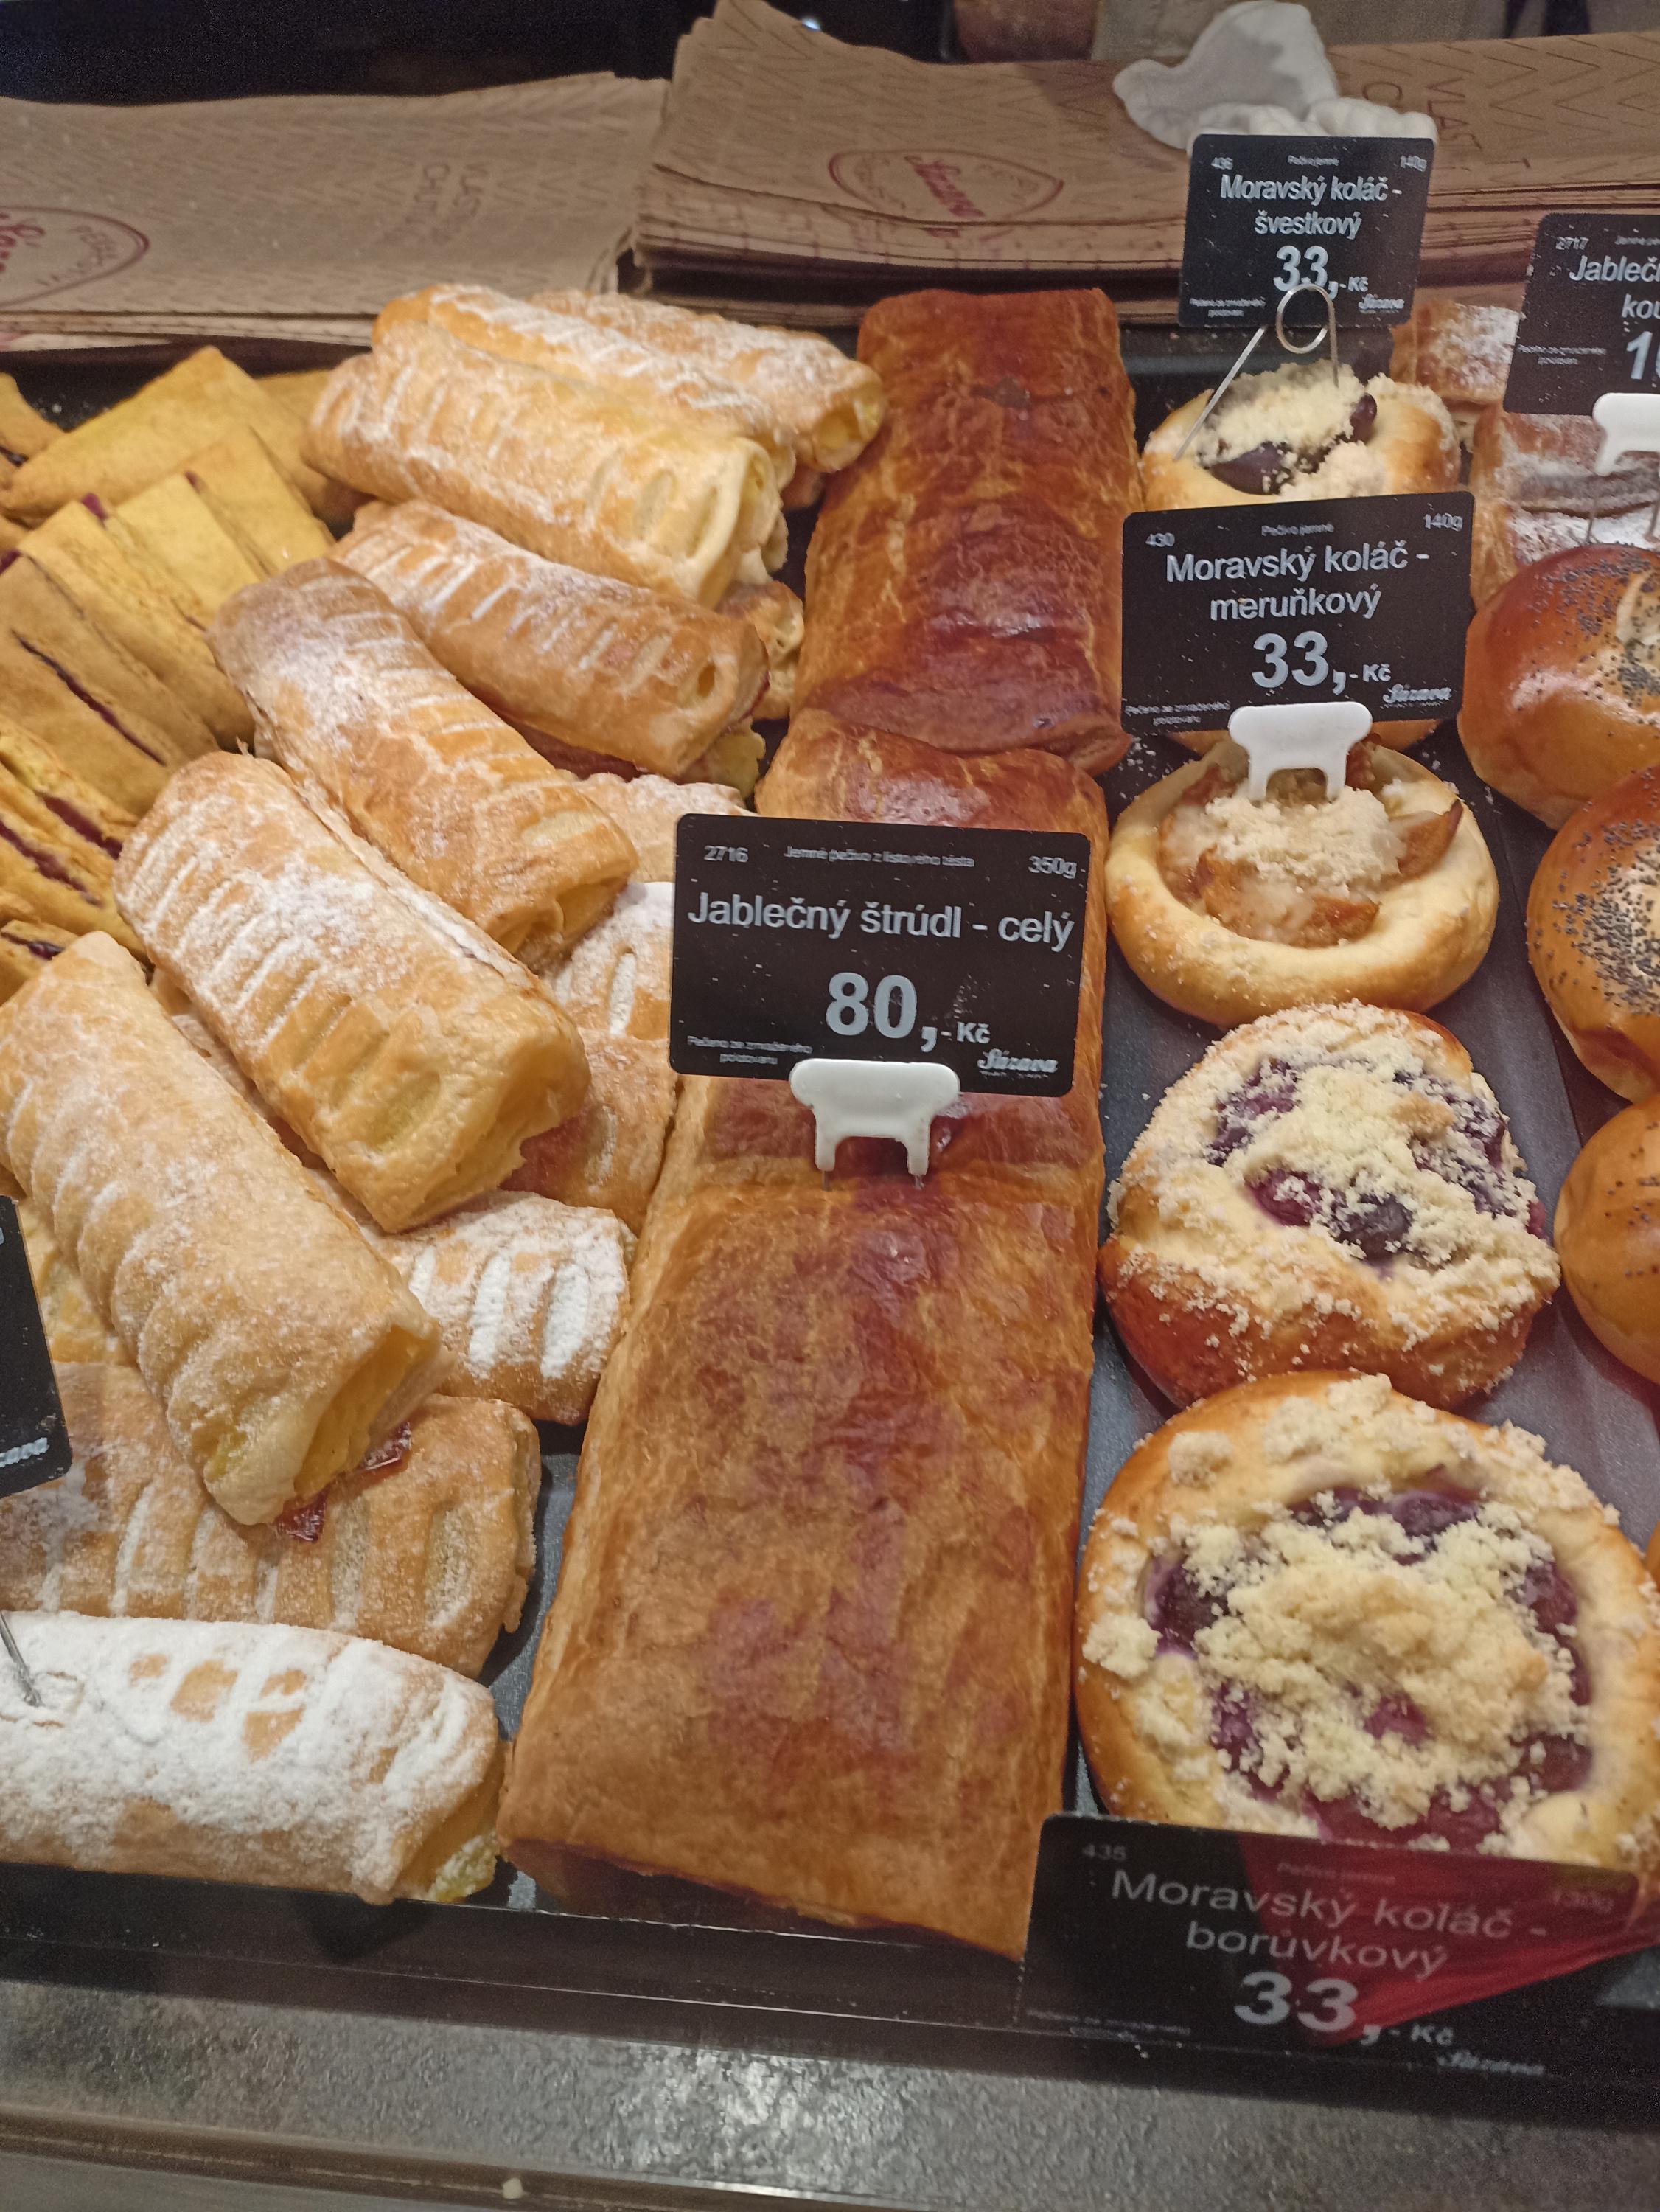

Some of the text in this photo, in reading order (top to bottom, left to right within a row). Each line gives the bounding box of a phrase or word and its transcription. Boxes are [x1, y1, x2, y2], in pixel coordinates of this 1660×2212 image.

[1220, 174, 1327, 206] Moravský
[1331, 176, 1388, 201] koláč
[1255, 210, 1362, 240] švestkový
[1569, 255, 1660, 282] Jableč
[1626, 332, 1660, 380] 1
[1166, 545, 1317, 582] Moravský
[1324, 540, 1408, 573] koláč
[1210, 583, 1382, 621] meruňkový
[1363, 664, 1392, 682] Kč
[703, 845, 748, 863] 2716
[1028, 855, 1077, 879] 350g
[688, 892, 851, 939] Jablečný
[859, 902, 961, 938] štrúdl
[997, 910, 1075, 953] celý
[958, 1021, 990, 1045] Kč
[1110, 1868, 1357, 1928] Moravský
[1373, 1896, 1514, 1939] koláč
[1185, 1919, 1448, 1983] borůvkový
